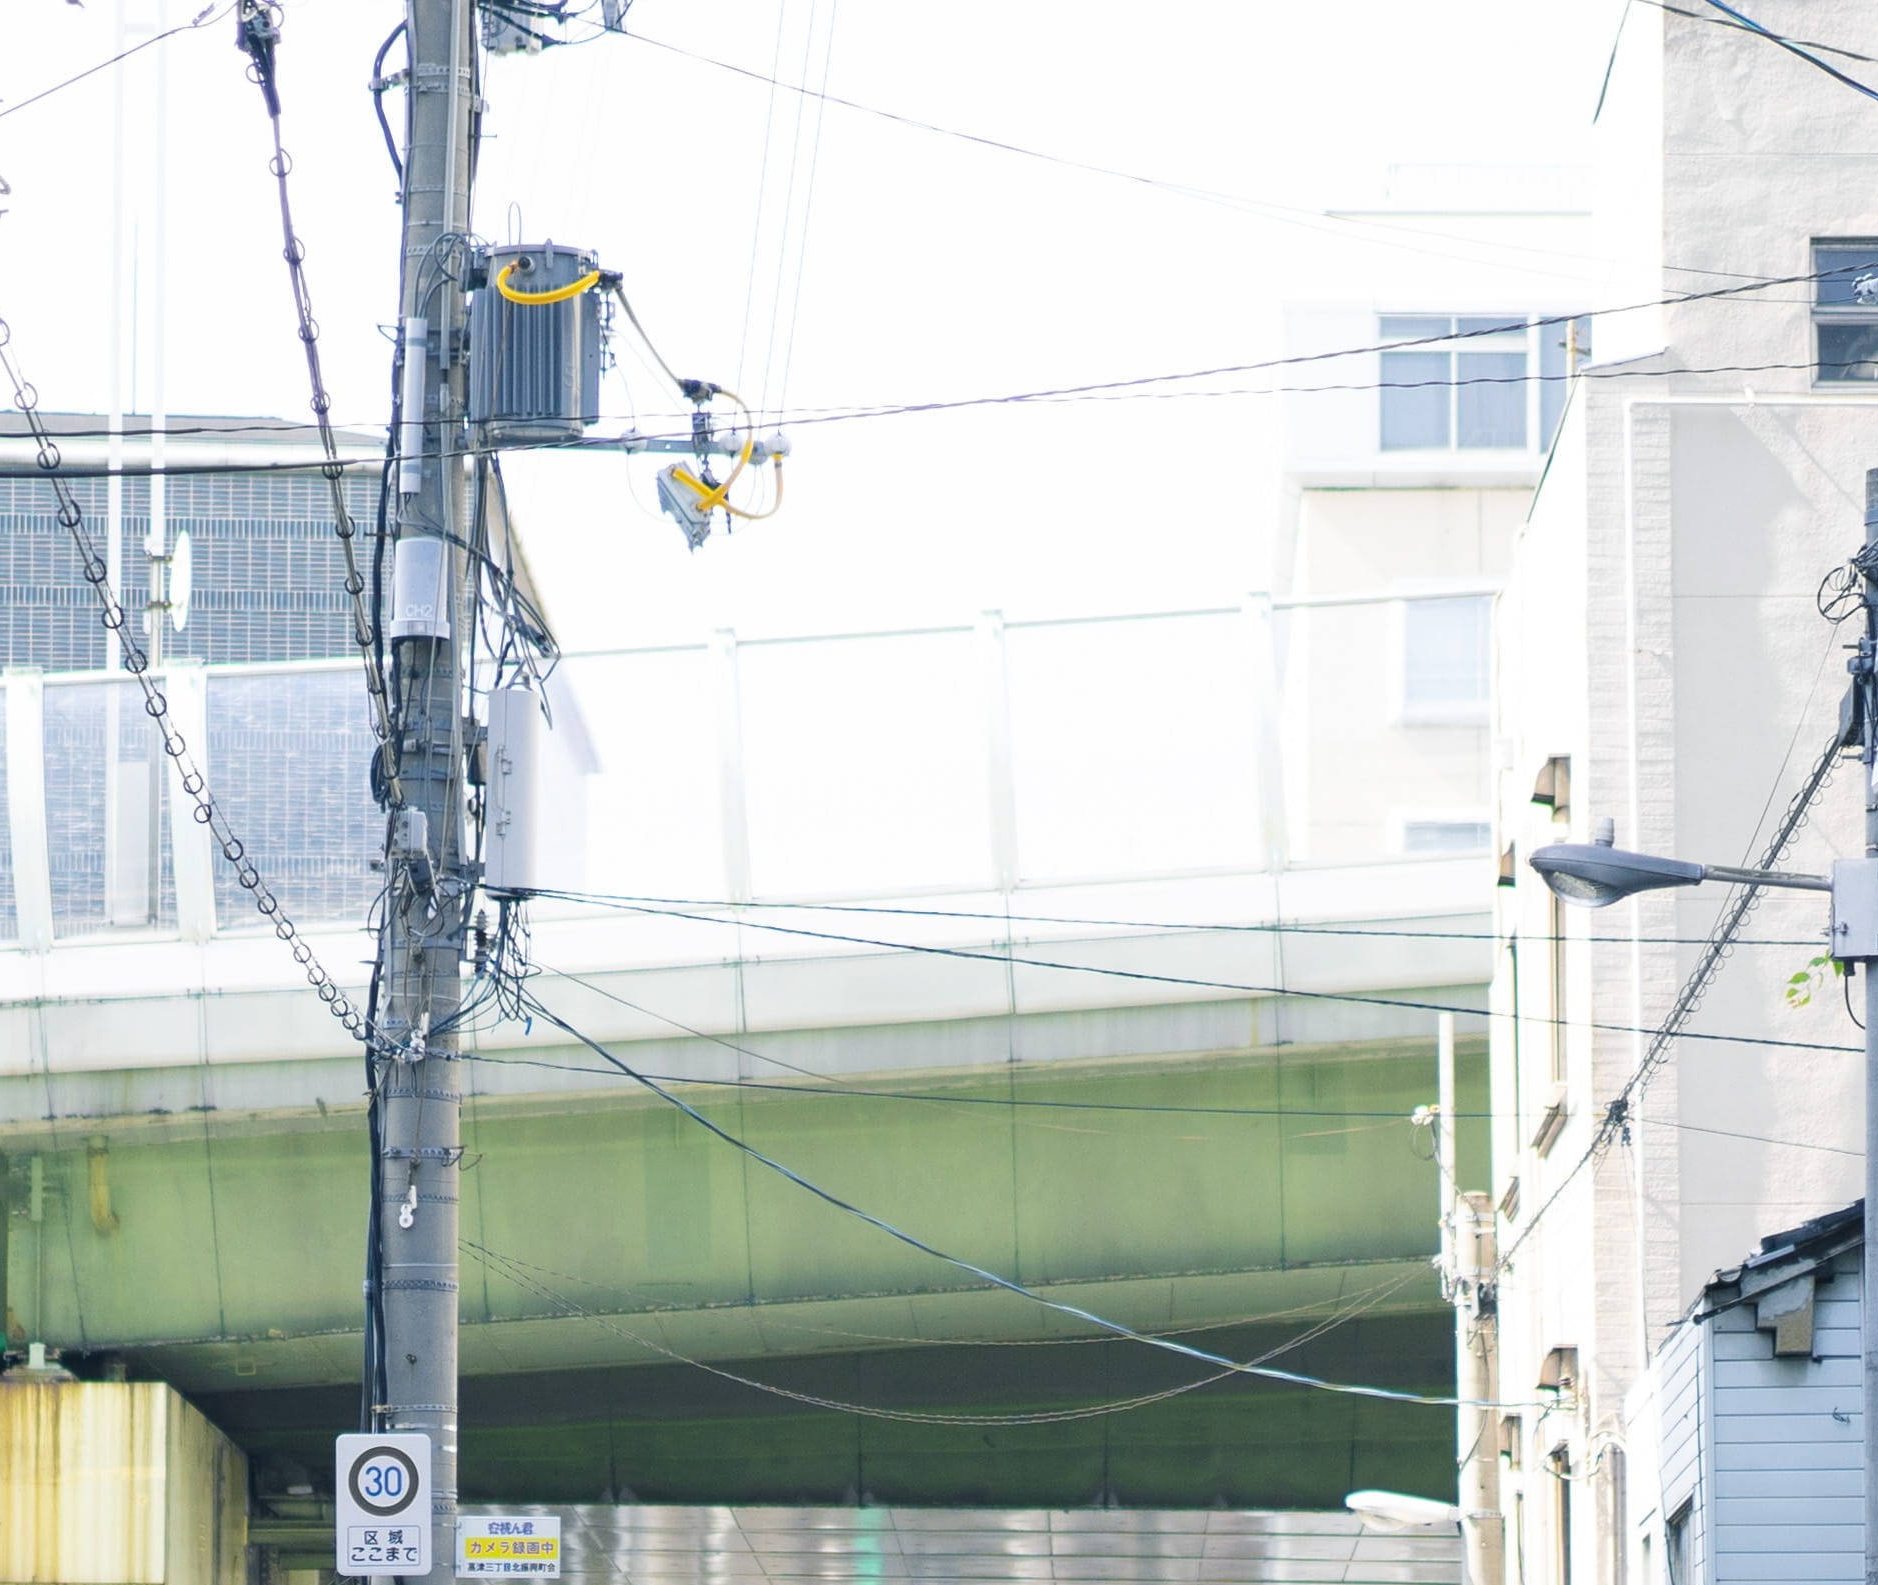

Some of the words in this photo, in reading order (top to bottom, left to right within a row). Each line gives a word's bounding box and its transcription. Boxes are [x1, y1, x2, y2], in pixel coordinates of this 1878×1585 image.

[405, 604, 433, 618] CH2
[364, 1465, 403, 1497] 30
[364, 1529, 403, 1545] 区域
[350, 1546, 417, 1562] ここまで
[470, 1541, 554, 1555] カメラ録画中
